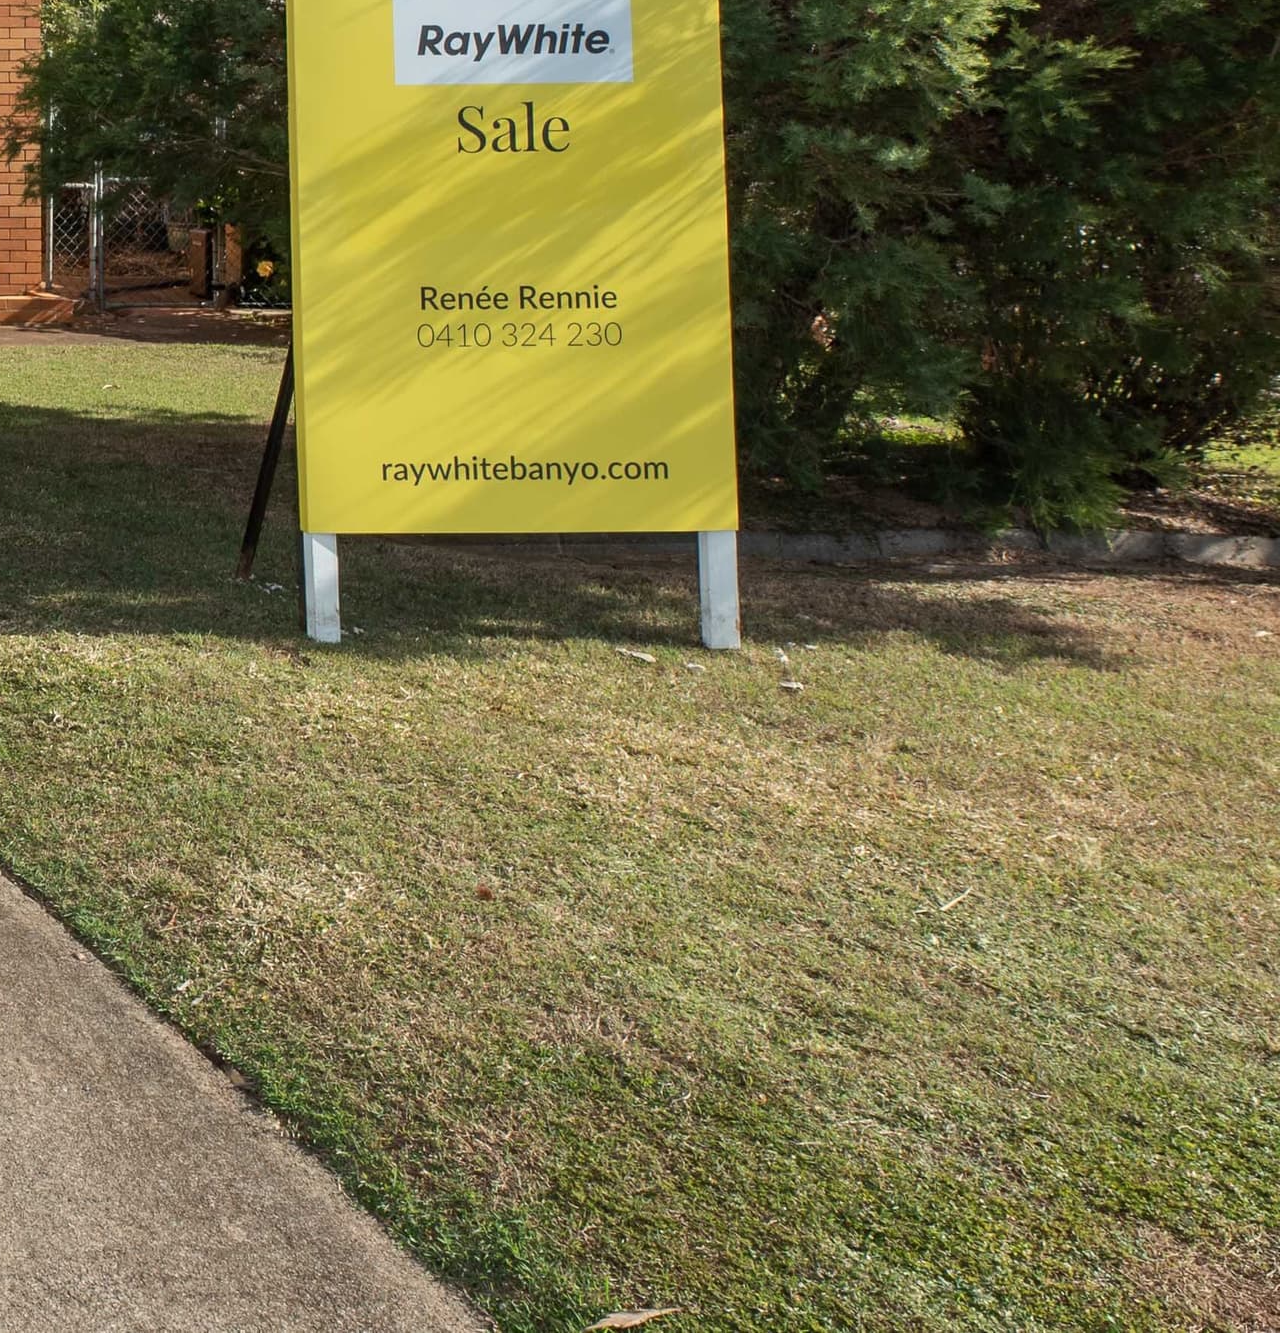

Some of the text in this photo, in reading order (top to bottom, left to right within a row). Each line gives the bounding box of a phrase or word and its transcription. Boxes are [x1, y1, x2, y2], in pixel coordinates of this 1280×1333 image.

[457, 101, 570, 154] Sale
[420, 284, 618, 310] Renée Rennie
[416, 321, 623, 348] 0410 324 230
[381, 455, 670, 486] raywhitebanyo.com
